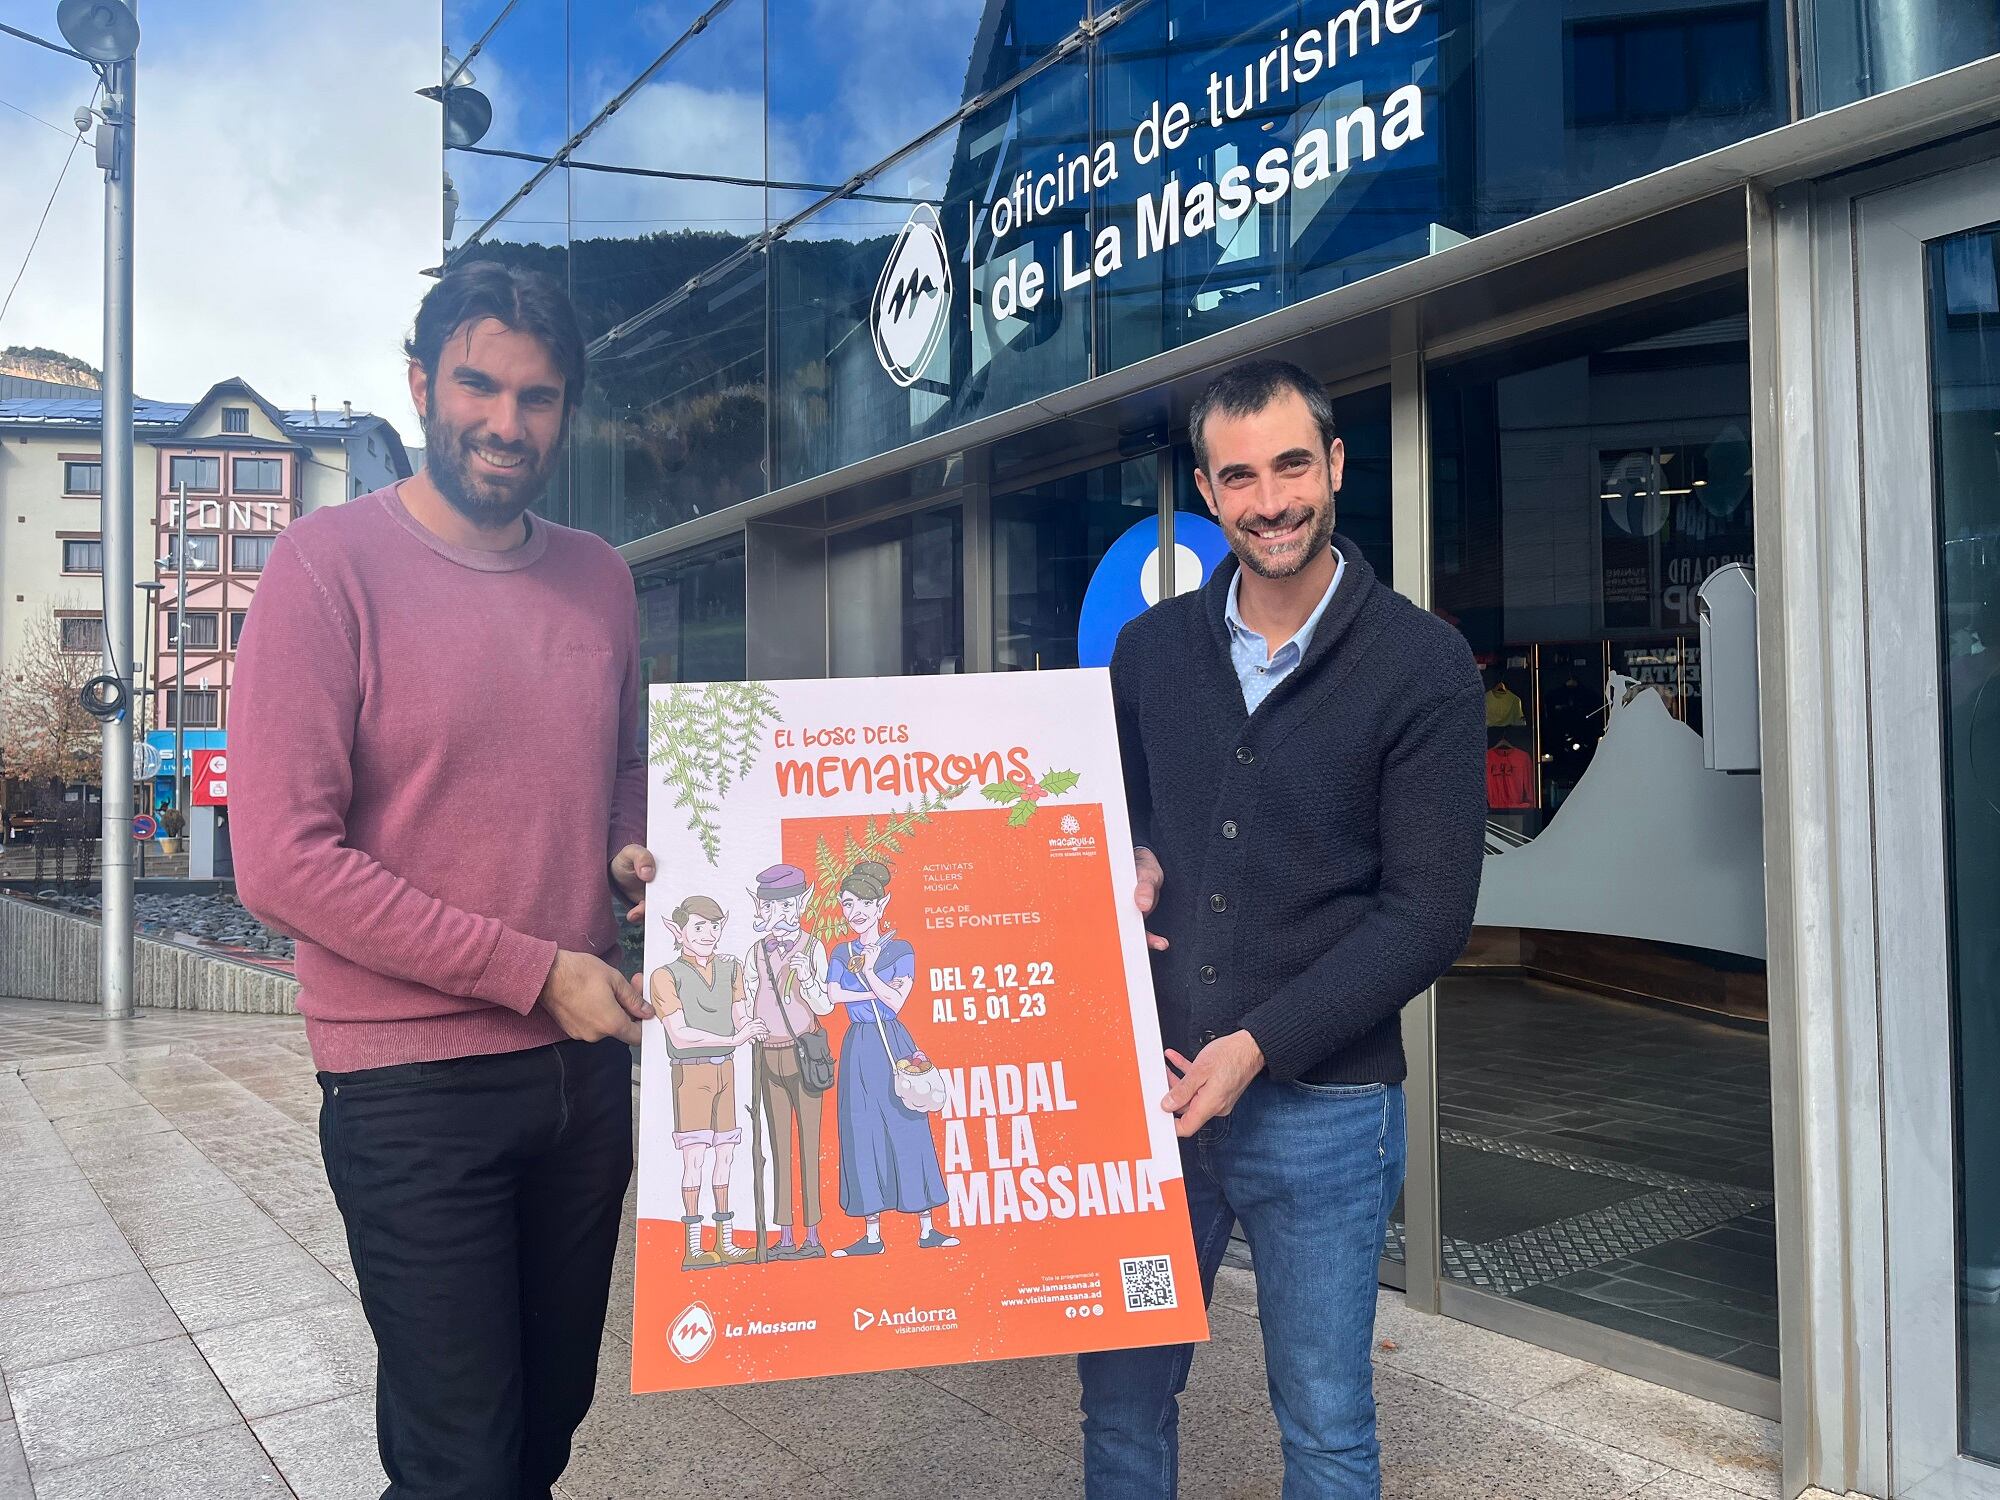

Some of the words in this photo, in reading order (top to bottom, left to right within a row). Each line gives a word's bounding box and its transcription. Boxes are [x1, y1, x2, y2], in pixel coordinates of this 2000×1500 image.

[991, 139, 1118, 237] oficina
[1133, 100, 1190, 164] de
[1207, 0, 1421, 126] turisme
[992, 257, 1043, 321] de
[1064, 227, 1121, 293] La
[1137, 83, 1425, 259] Massana
[775, 729, 795, 748] EL
[863, 724, 909, 745] DELS
[922, 862, 974, 872] ACTIVITATS
[923, 873, 963, 882] TALLERS
[924, 906, 955, 915] PLAÇA
[958, 905, 970, 913] DE
[926, 916, 954, 930] LES
[959, 911, 1041, 927] FONTETES
[930, 967, 966, 992] DEL
[971, 961, 1055, 992] 2_12_22
[932, 998, 957, 1024] AL
[963, 992, 1046, 1024] 5_01_23
[939, 1060, 1077, 1119] NADAL
[944, 1119, 972, 1173] A
[985, 1114, 1039, 1170] LA
[946, 1158, 1165, 1228] MASSANA
[1018, 1279, 1101, 1294] www.lamassana.ad
[1000, 1290, 1102, 1307] www.visitlamassana.ad
[878, 1306, 957, 1327] Andorra
[725, 1322, 743, 1338] La
[748, 1319, 817, 1336] Massana
[895, 1322, 958, 1335] visitandorra.com
